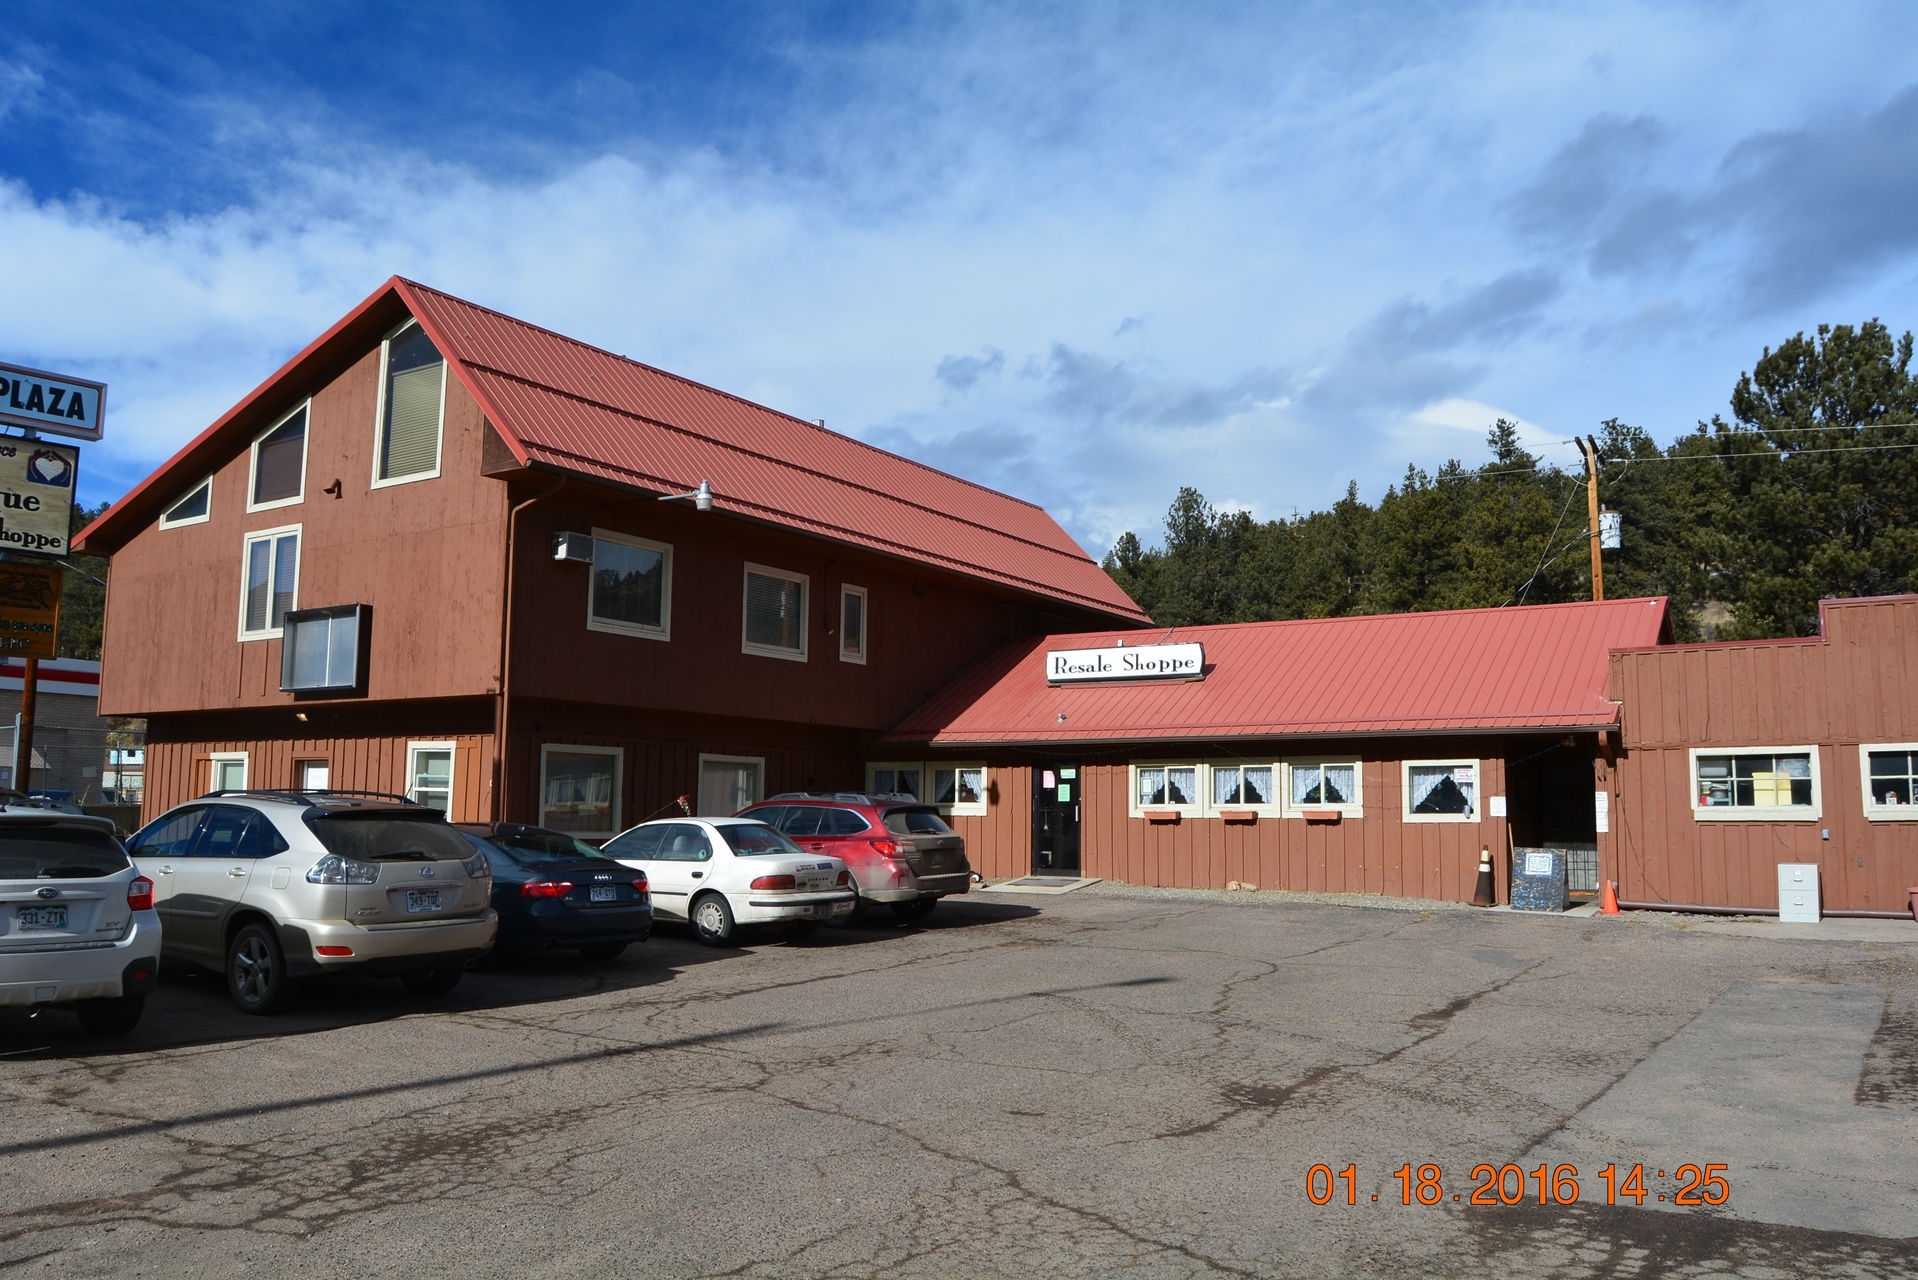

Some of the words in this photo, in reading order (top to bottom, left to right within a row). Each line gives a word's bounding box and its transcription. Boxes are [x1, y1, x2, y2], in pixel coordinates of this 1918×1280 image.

[0, 491, 40, 512] ue
[1053, 655, 1113, 675] Resale
[1122, 653, 1195, 673] Shoppe
